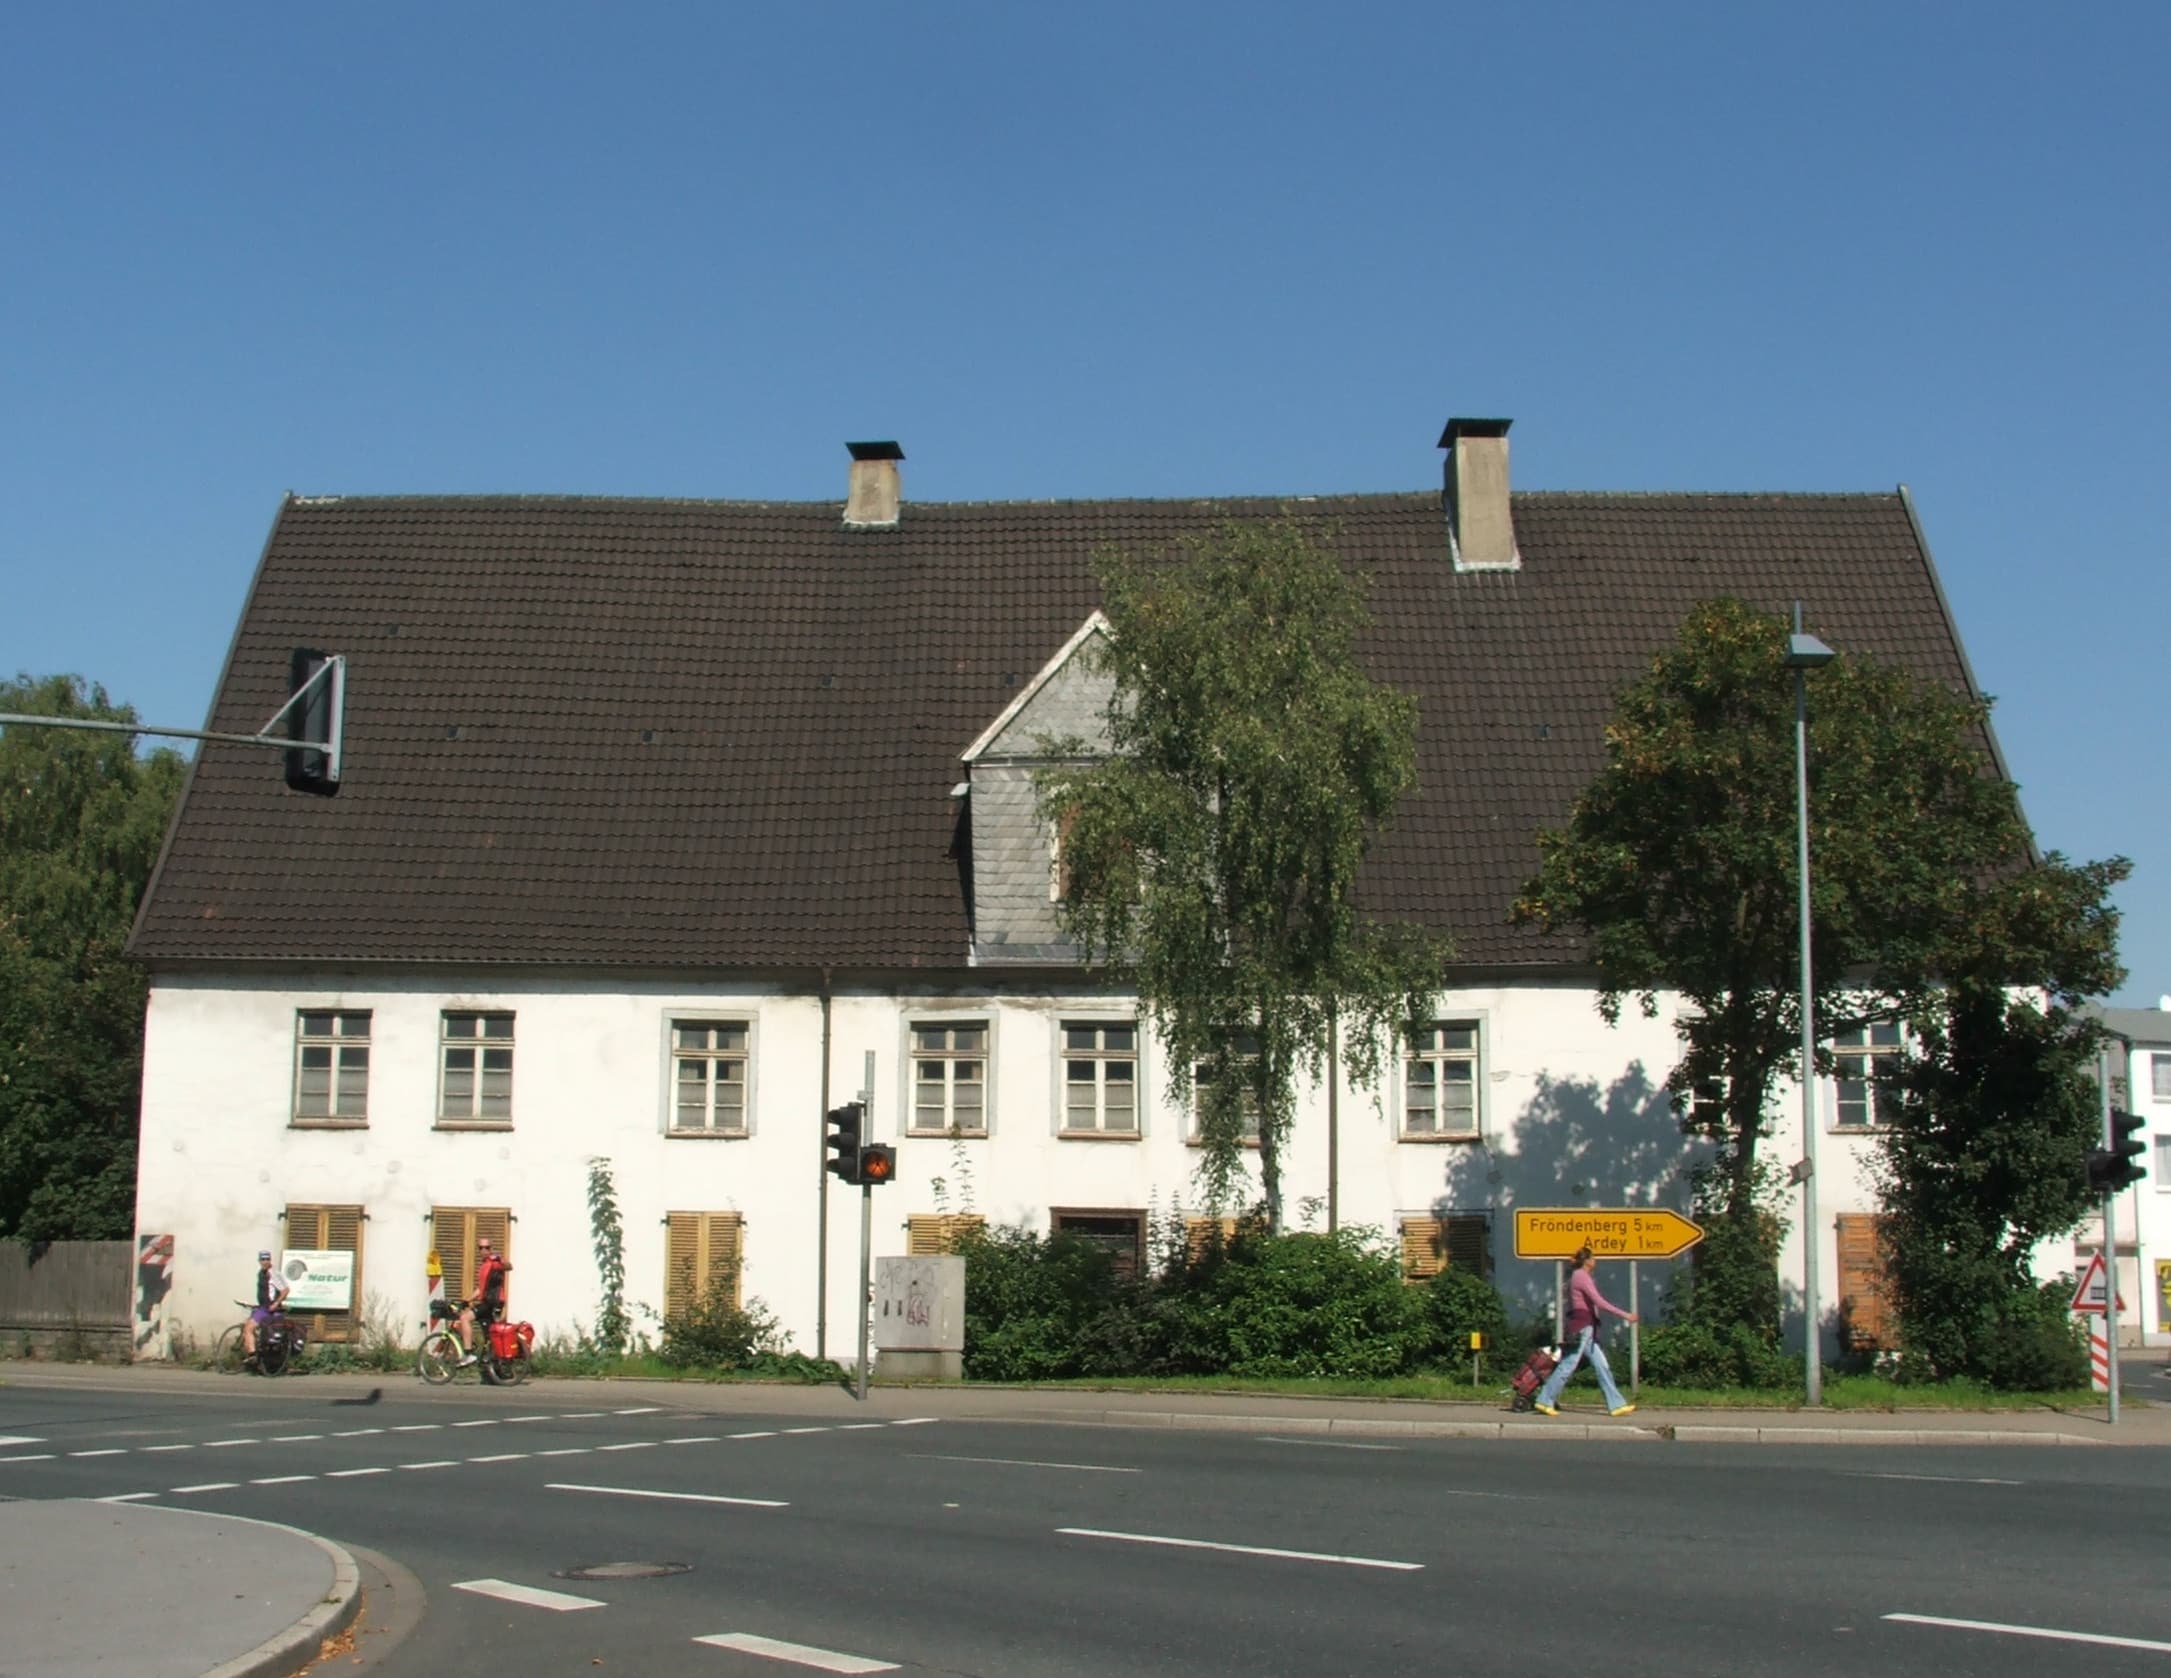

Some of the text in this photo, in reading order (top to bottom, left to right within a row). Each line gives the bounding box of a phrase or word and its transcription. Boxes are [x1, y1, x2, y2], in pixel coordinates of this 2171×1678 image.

[1530, 1218, 1664, 1235] Fröndenberg 5 km
[1583, 1235, 1664, 1252] Ardey 1 km
[308, 1274, 348, 1282] Natur
